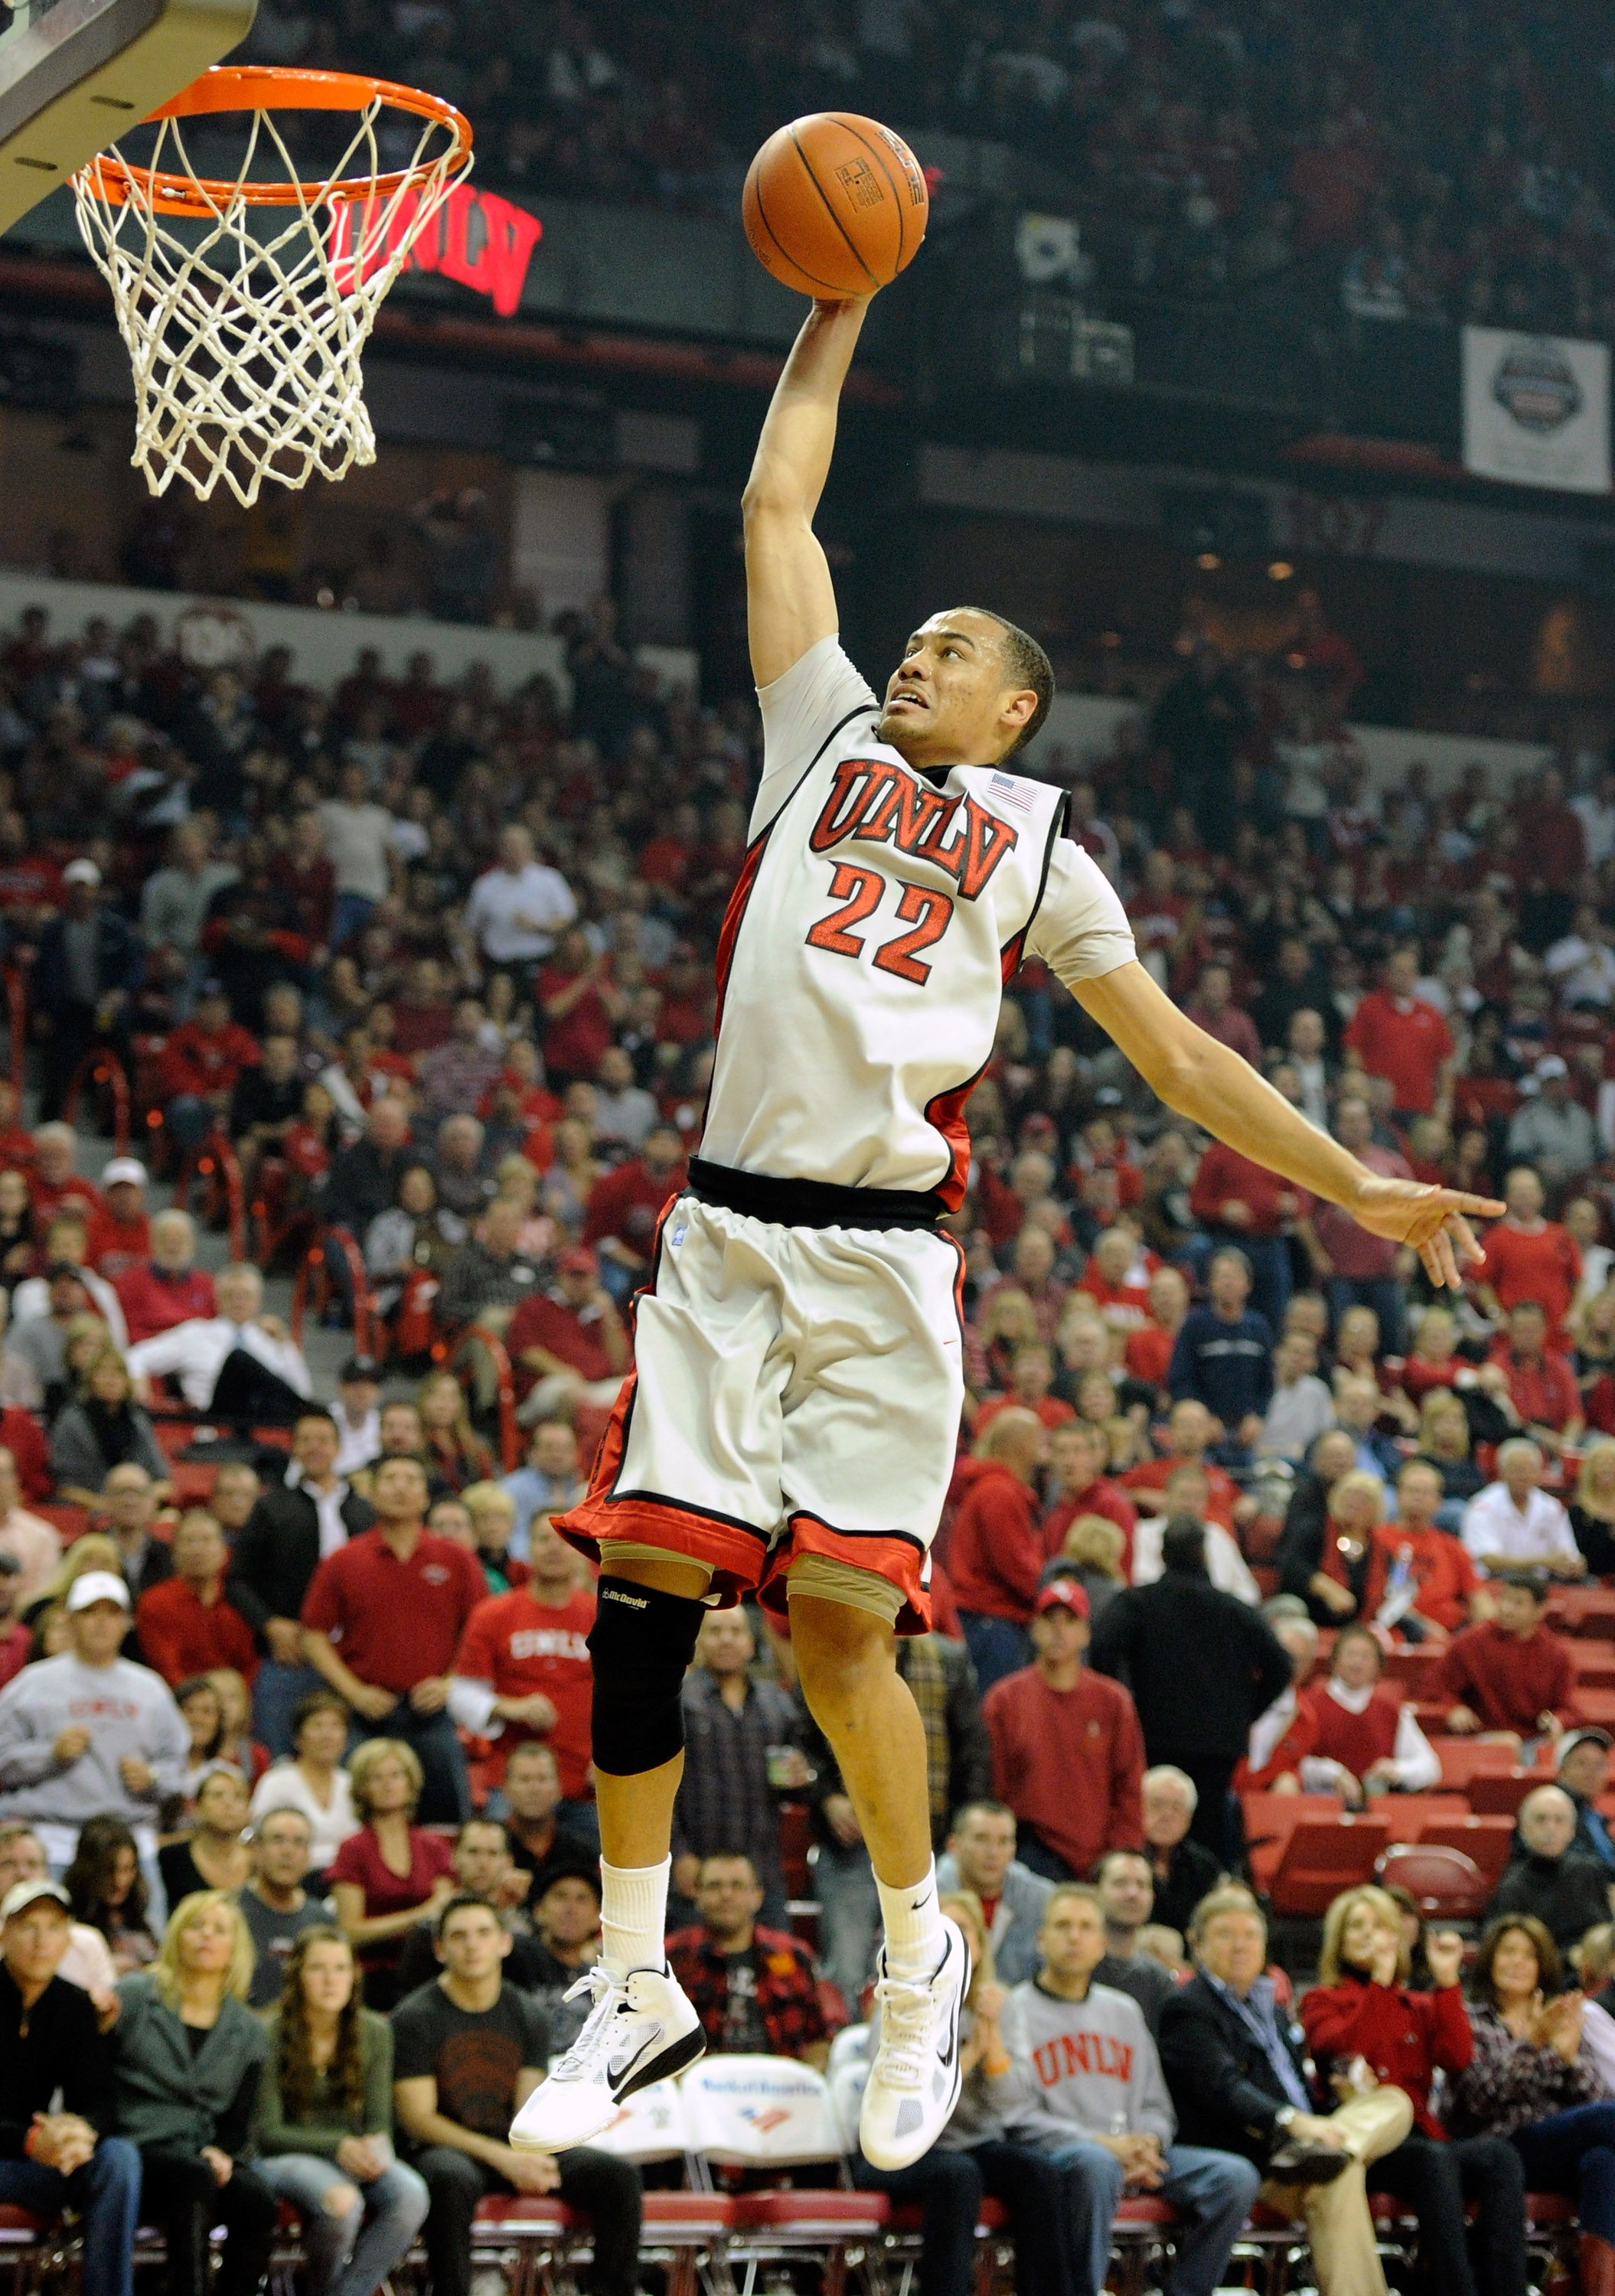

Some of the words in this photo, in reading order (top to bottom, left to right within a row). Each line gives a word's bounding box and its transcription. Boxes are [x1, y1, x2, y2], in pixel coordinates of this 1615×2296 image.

[328, 179, 543, 317] UNLV
[809, 758, 1019, 902] UNLV
[804, 859, 954, 987] 22
[608, 1590, 648, 1609] McDavid
[1033, 2032, 1133, 2087] UNLV
